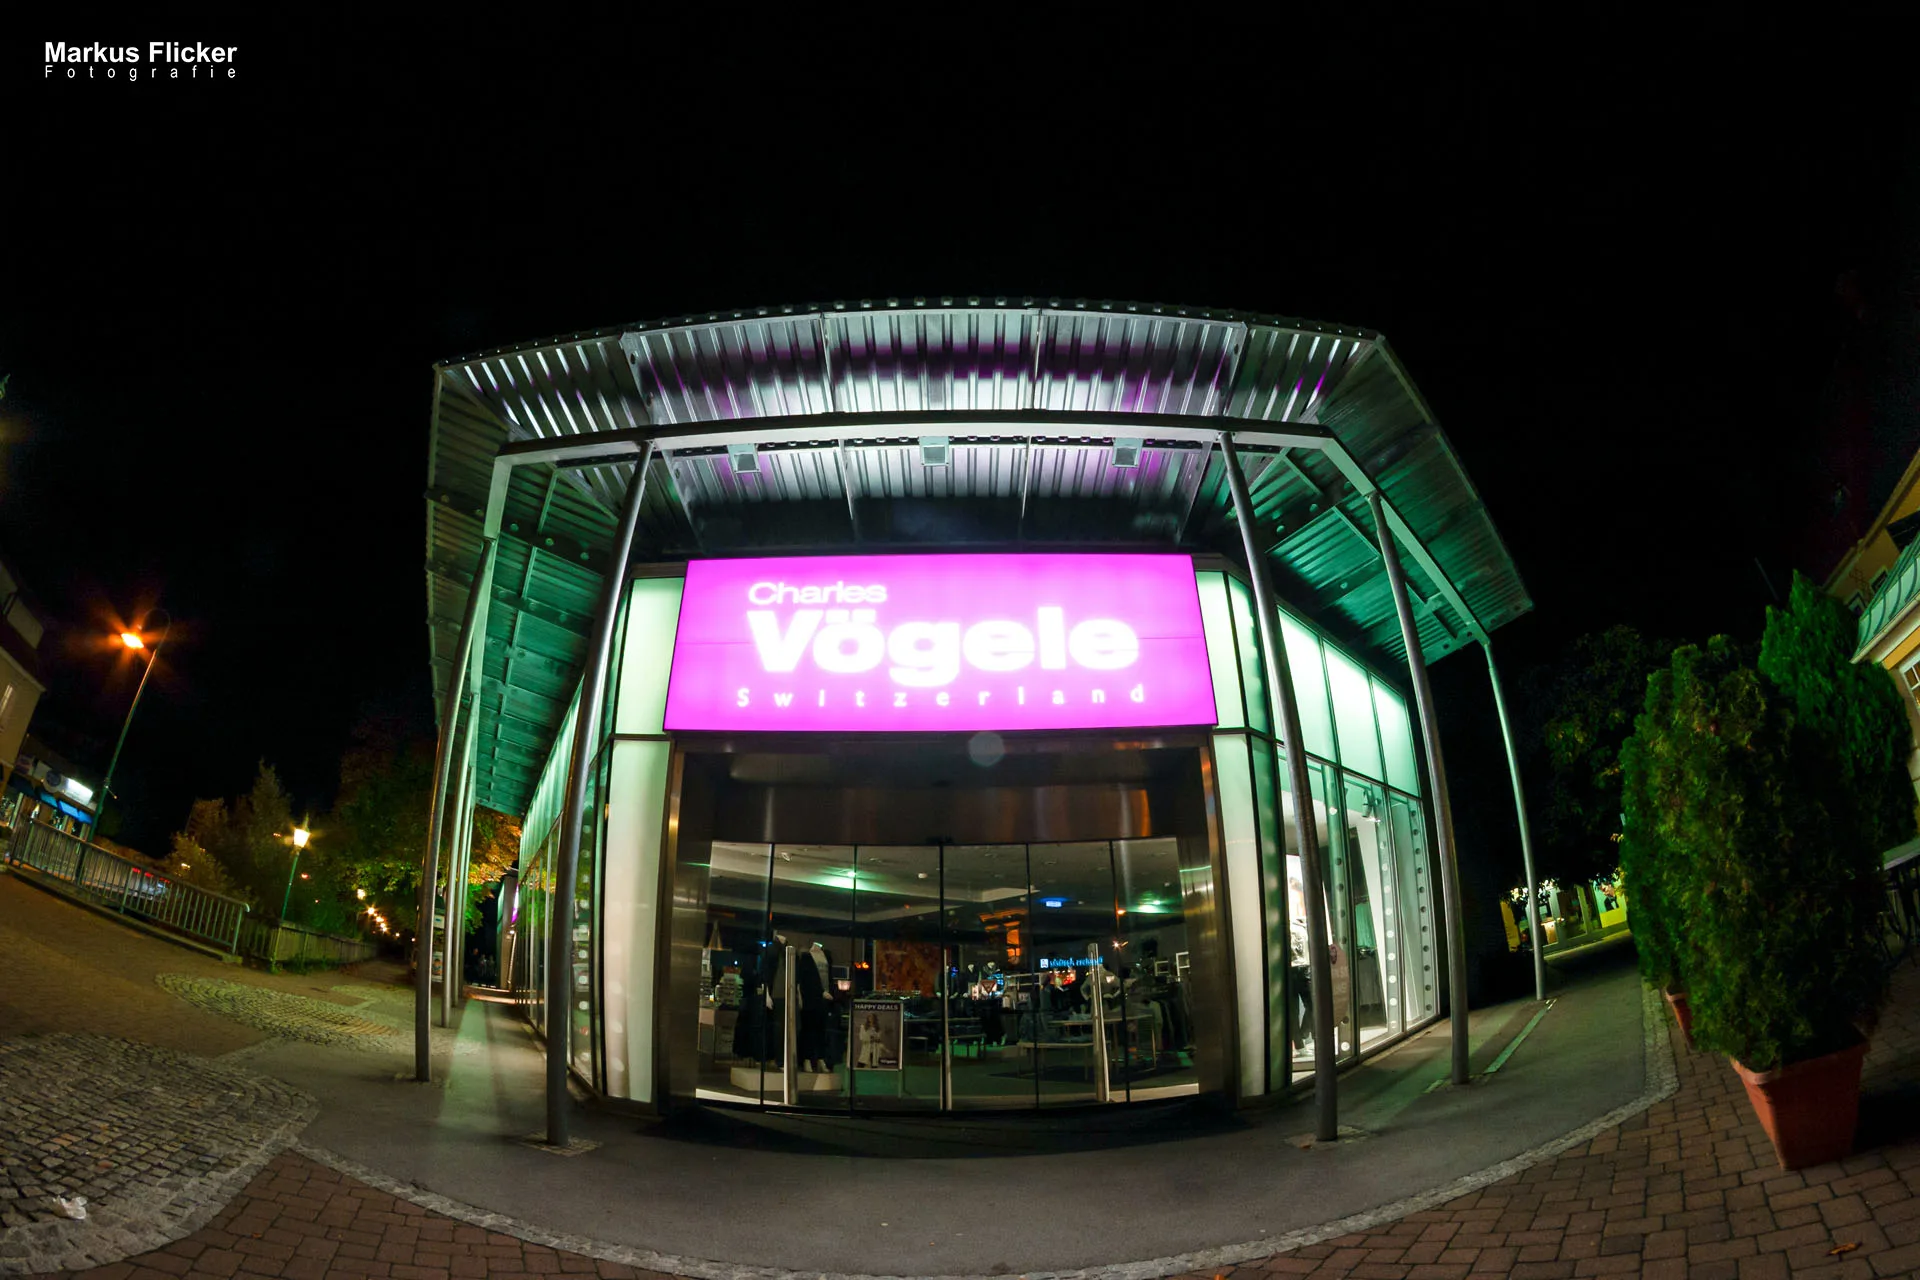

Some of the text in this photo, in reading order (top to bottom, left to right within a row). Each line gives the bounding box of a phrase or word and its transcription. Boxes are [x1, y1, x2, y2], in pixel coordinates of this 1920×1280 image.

[748, 580, 888, 605] Charles
[746, 606, 1139, 687] Vögele
[736, 683, 1145, 708] Switzerland
